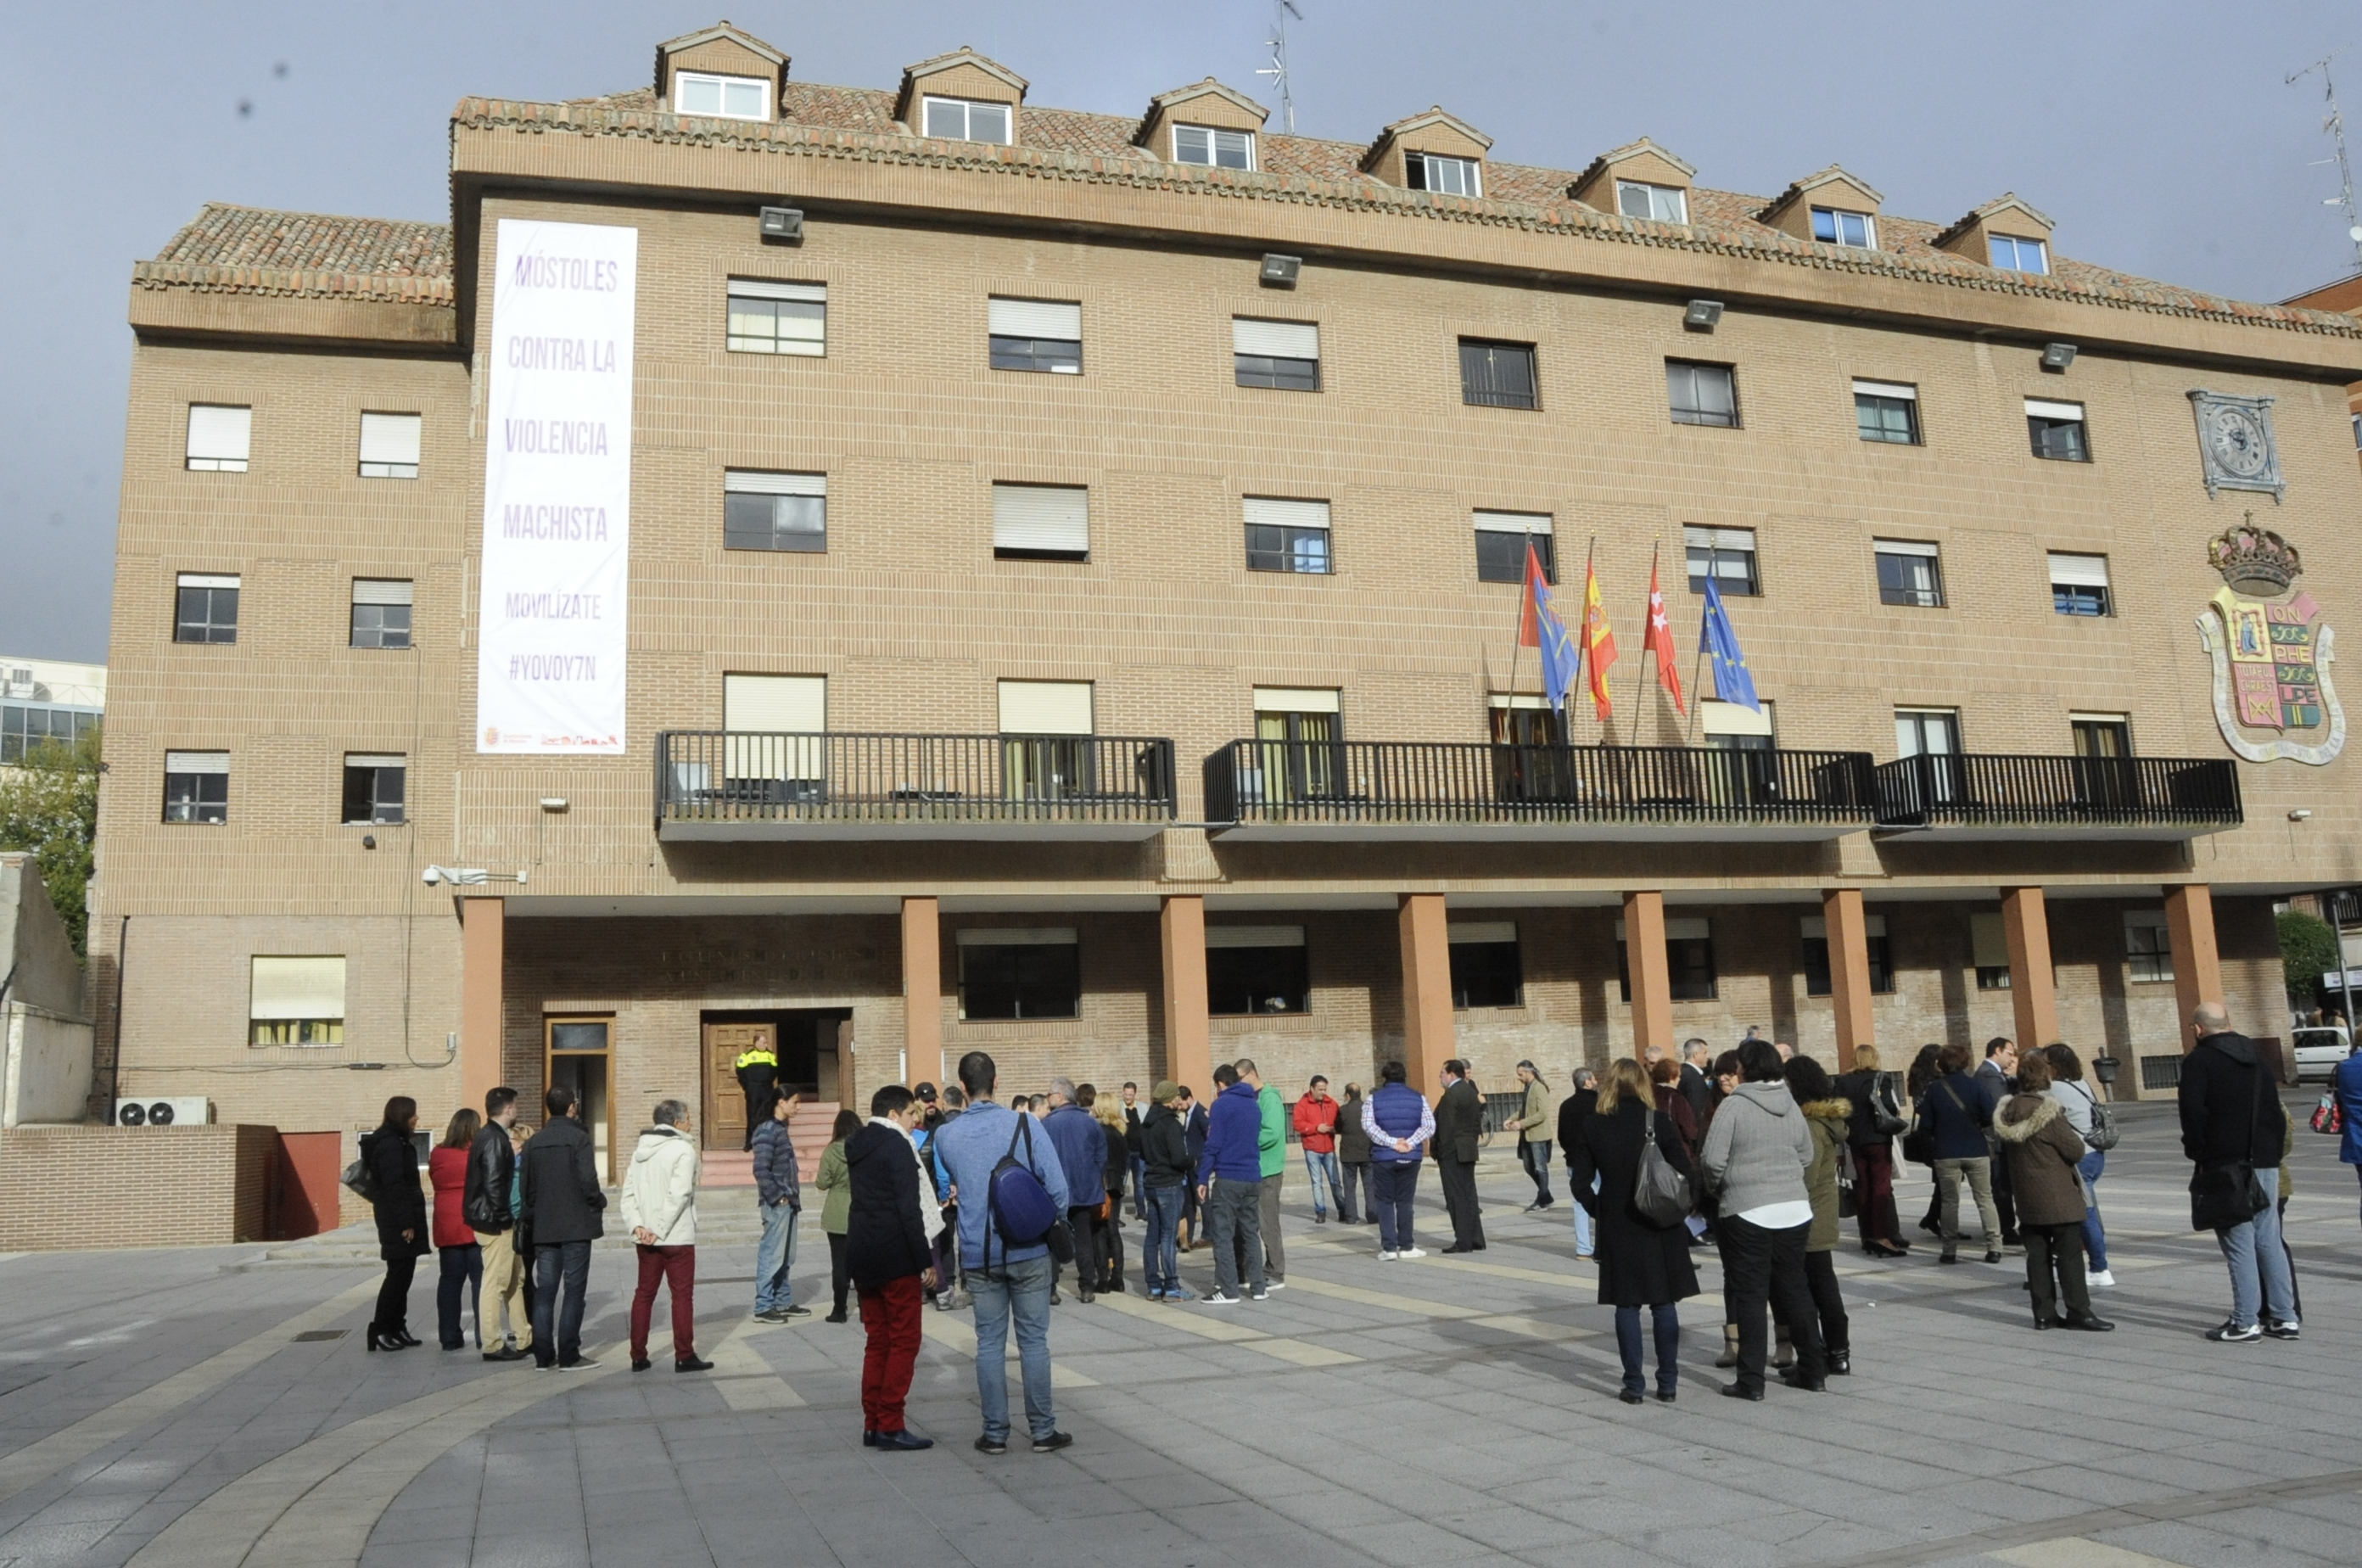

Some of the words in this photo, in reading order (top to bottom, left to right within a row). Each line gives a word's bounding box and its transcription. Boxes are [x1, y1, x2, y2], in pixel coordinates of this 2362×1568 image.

[514, 249, 618, 293] MÓSTOLES
[508, 335, 587, 372] CONTRA
[593, 339, 617, 372] LA
[506, 418, 608, 456] VIOLENCIA
[503, 504, 608, 542] MACHISTA
[506, 589, 602, 619] MOVILÍZATE
[2272, 607, 2301, 624] ON
[509, 654, 596, 681] #YOVOY7N
[2274, 646, 2313, 663] PHE
